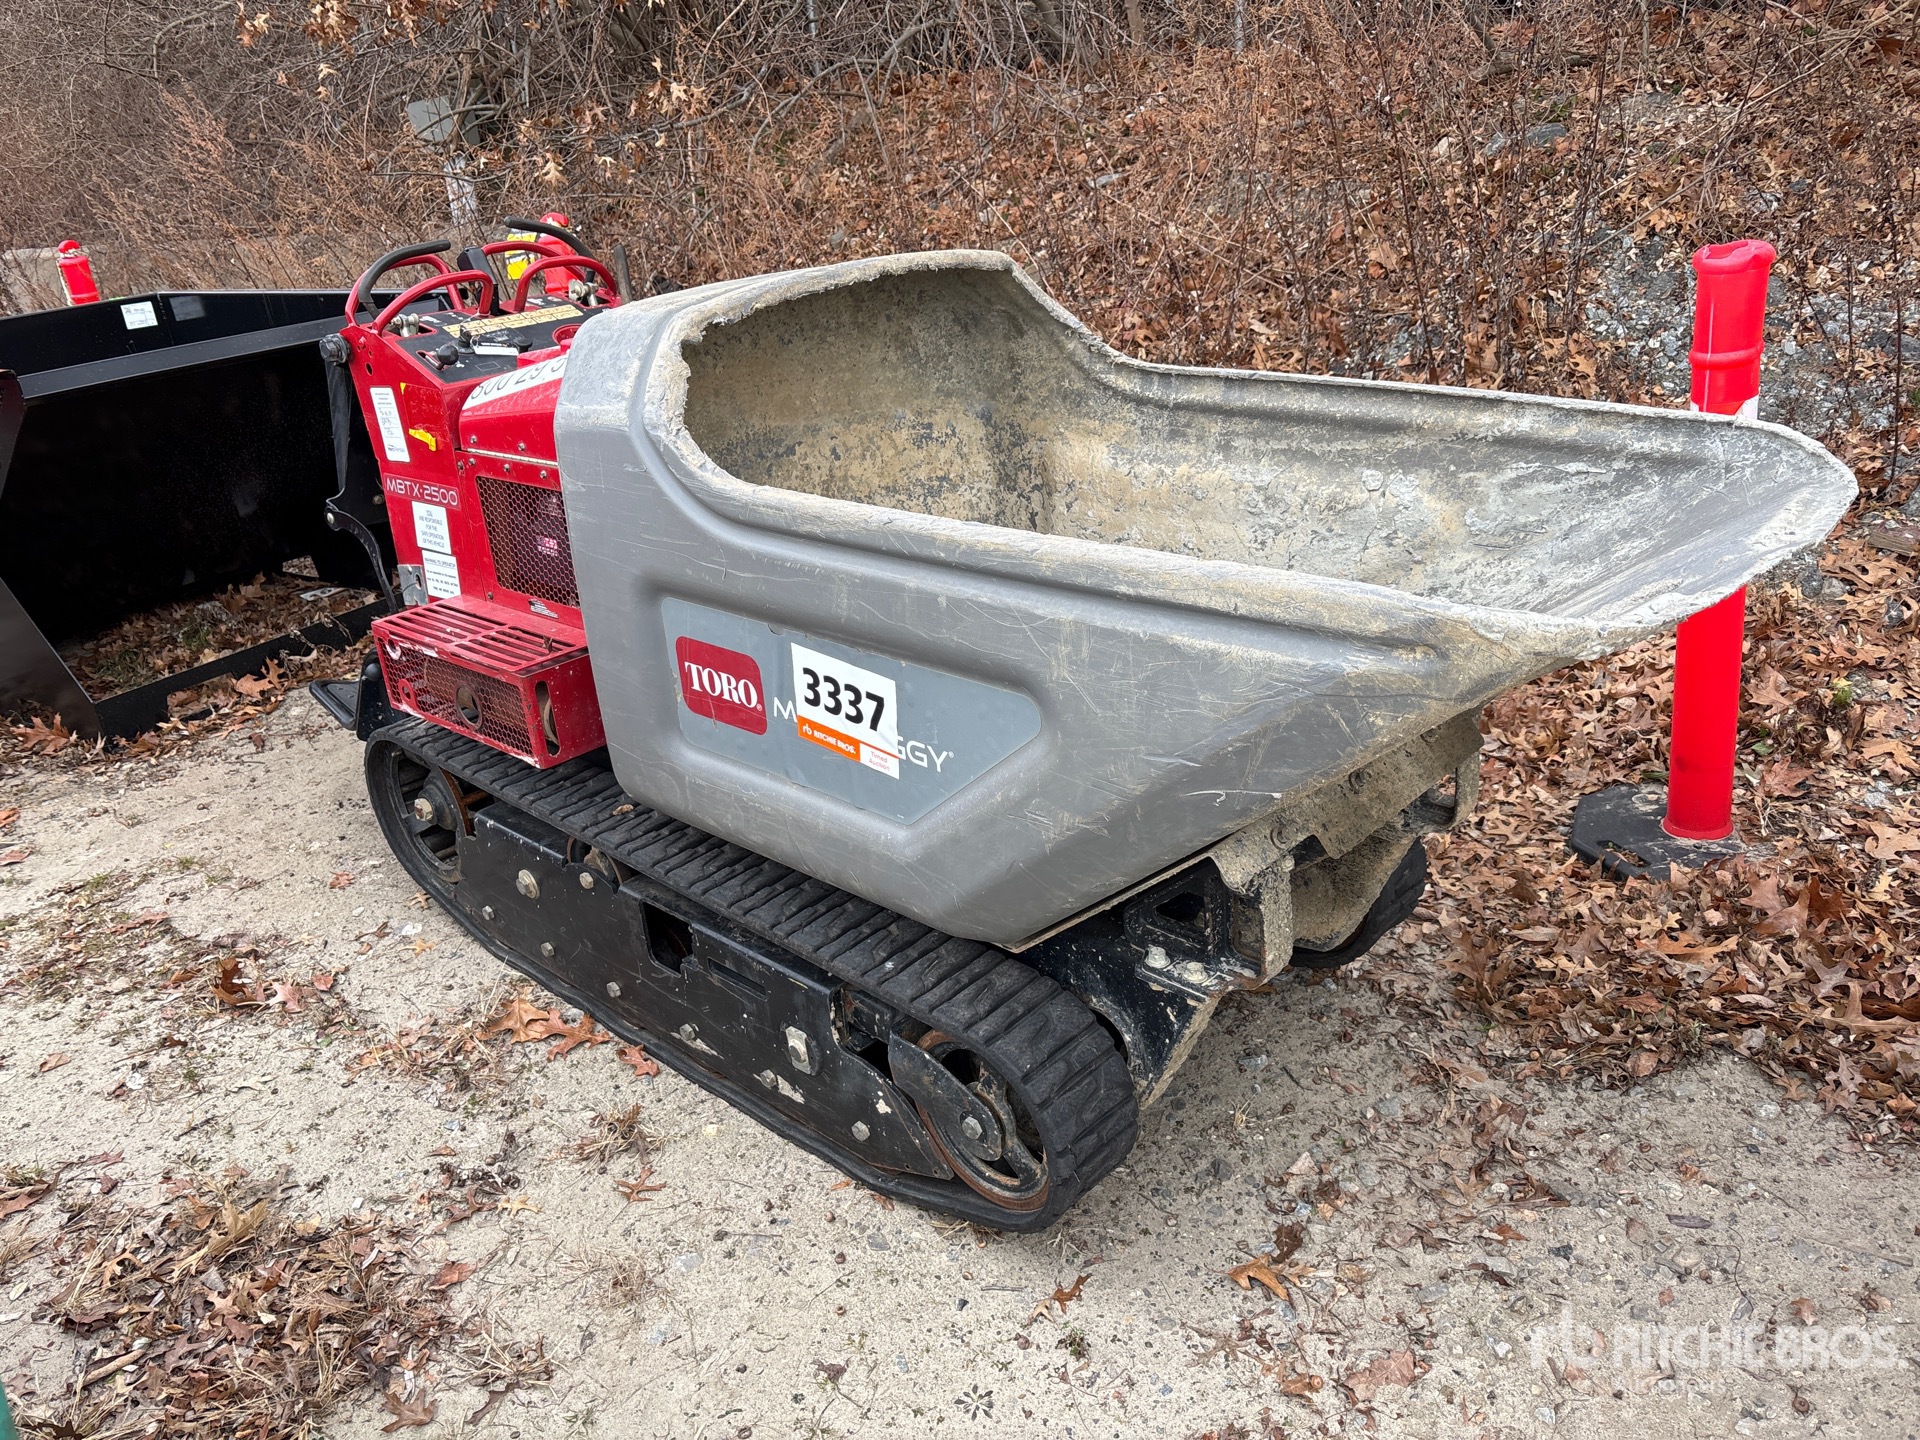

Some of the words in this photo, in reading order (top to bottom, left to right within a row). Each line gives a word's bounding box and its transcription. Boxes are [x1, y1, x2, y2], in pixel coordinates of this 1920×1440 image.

[802, 667, 885, 732] 3337
[813, 729, 837, 747] RITCHIE
[837, 739, 857, 755] BROS.
[868, 758, 890, 771] Auction
[870, 750, 888, 763] Timed
